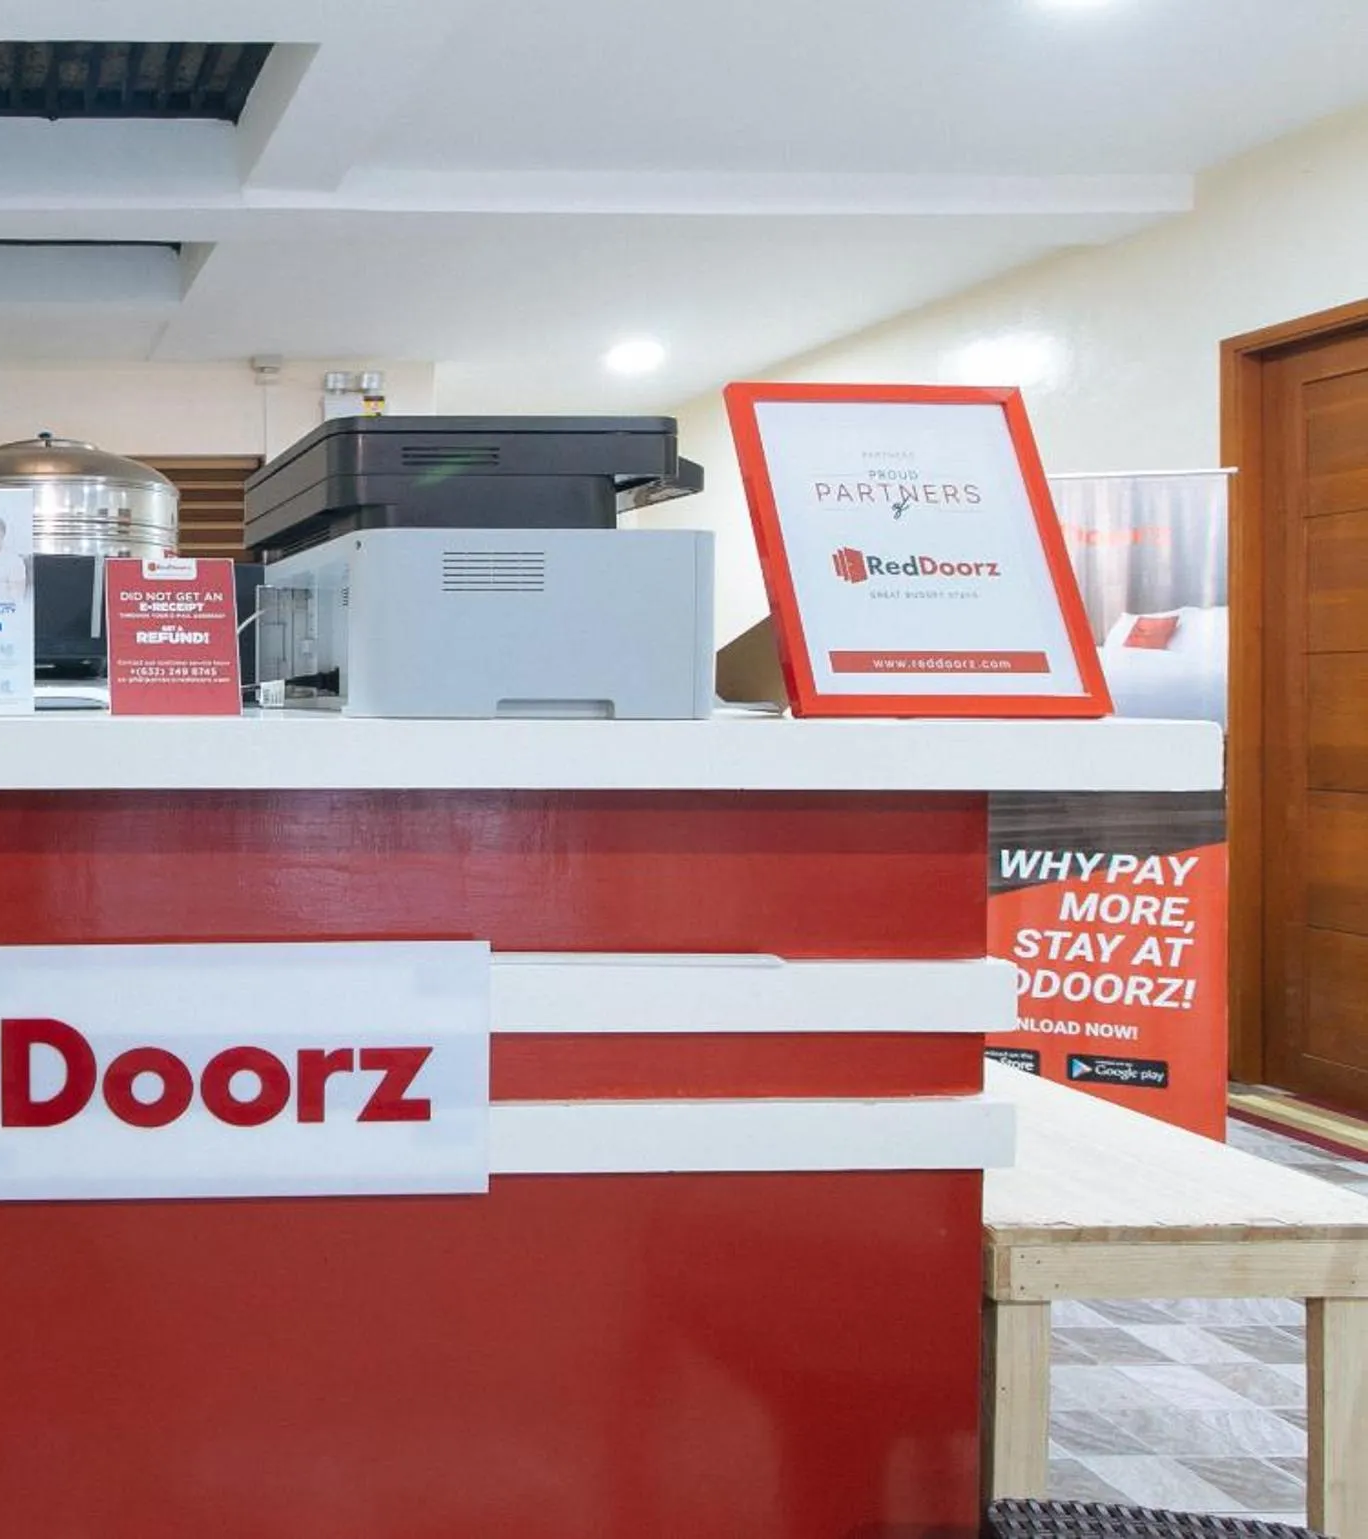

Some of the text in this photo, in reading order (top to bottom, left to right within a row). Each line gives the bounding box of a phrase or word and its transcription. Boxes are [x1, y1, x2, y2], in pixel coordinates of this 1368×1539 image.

[868, 470, 919, 479] PROUD
[815, 482, 982, 504] PARTNERS
[866, 555, 1001, 577] RedDoorz
[120, 592, 223, 601] DID NOT GET AN
[139, 602, 205, 612] E-RECEIPT
[136, 632, 209, 644] REFUND!
[873, 658, 1011, 669] www.reddoorz.com
[1000, 849, 1199, 886] WHY PAY
[1059, 892, 1196, 933] MORE,
[1013, 929, 1194, 967] STAY AT
[1017, 967, 1196, 1009] DOORZ!
[1017, 1016, 1139, 1040] NLOAD NOW!
[1094, 1064, 1165, 1082] Google play
